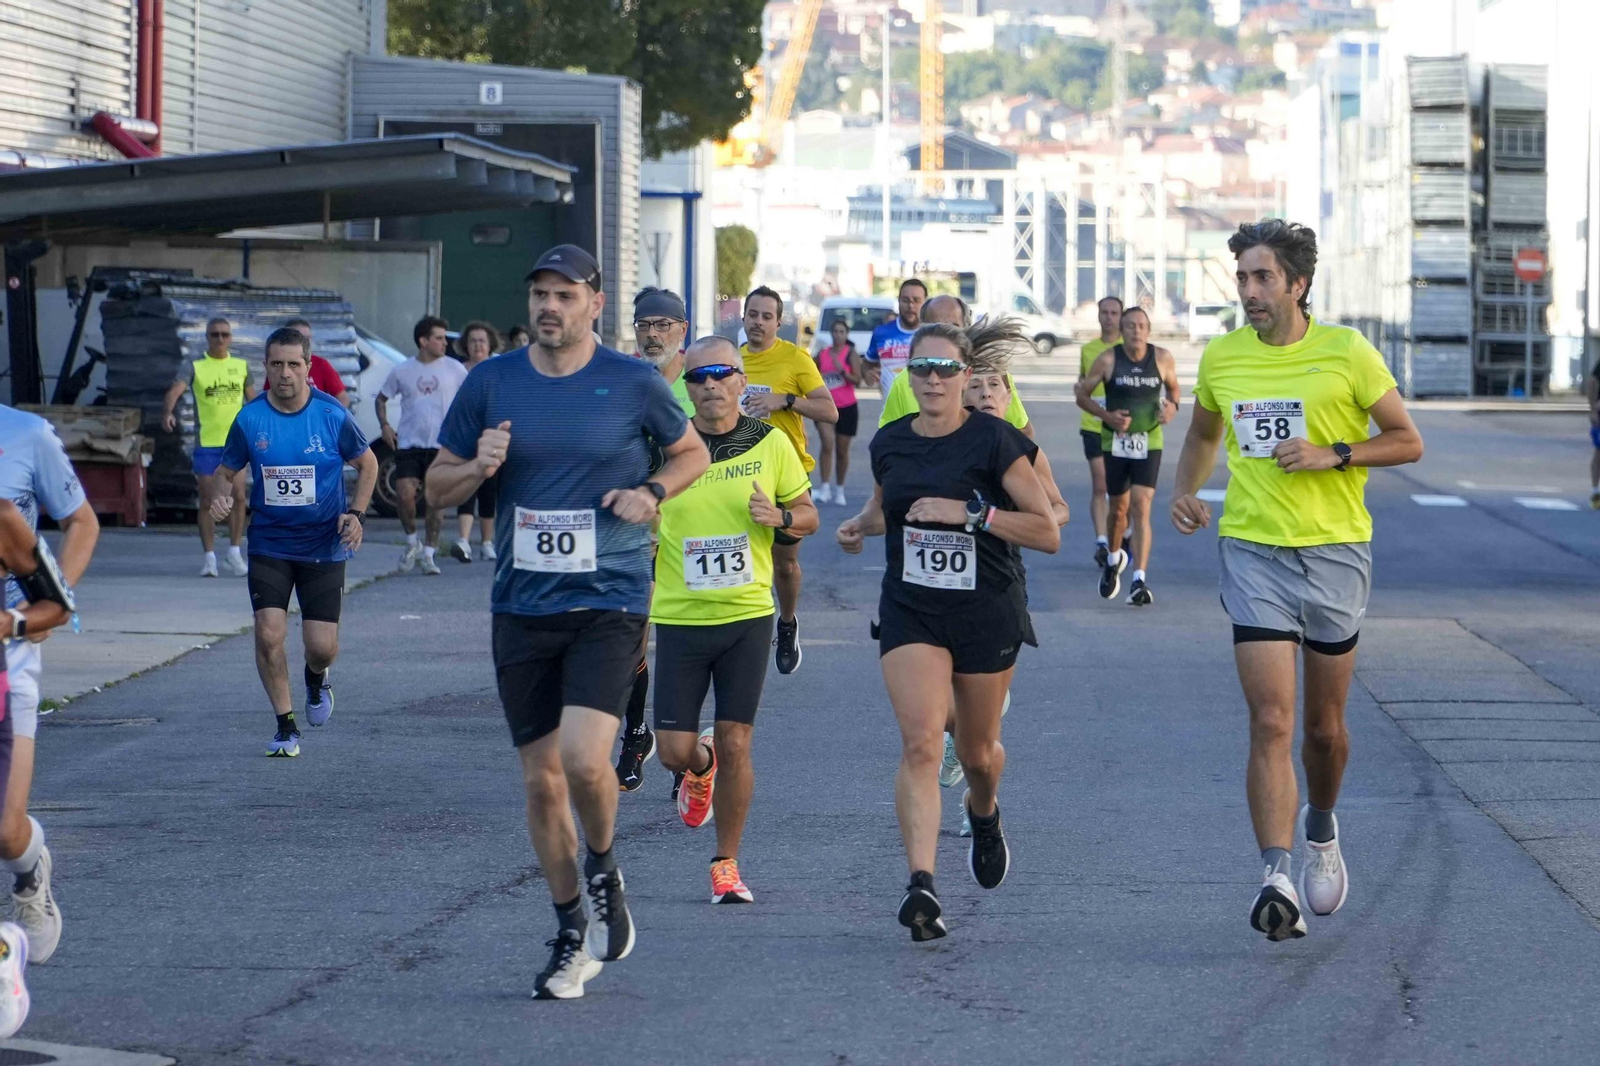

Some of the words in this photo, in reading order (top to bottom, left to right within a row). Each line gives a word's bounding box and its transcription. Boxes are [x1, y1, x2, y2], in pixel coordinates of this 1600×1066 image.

[1255, 402, 1284, 411] ALFONSO
[1285, 402, 1302, 410] MOO
[1254, 417, 1291, 441] 58
[1119, 439, 1144, 452] 140
[277, 479, 303, 495] 93
[538, 514, 571, 524] ALFONSO
[572, 513, 593, 523] MORO
[537, 531, 576, 556] 80
[704, 538, 732, 548] ALFONSO
[733, 535, 747, 545] MORO
[923, 533, 954, 544] ALFONSO
[955, 535, 973, 546] MORO
[695, 551, 746, 575] 113
[915, 548, 967, 574] 190
